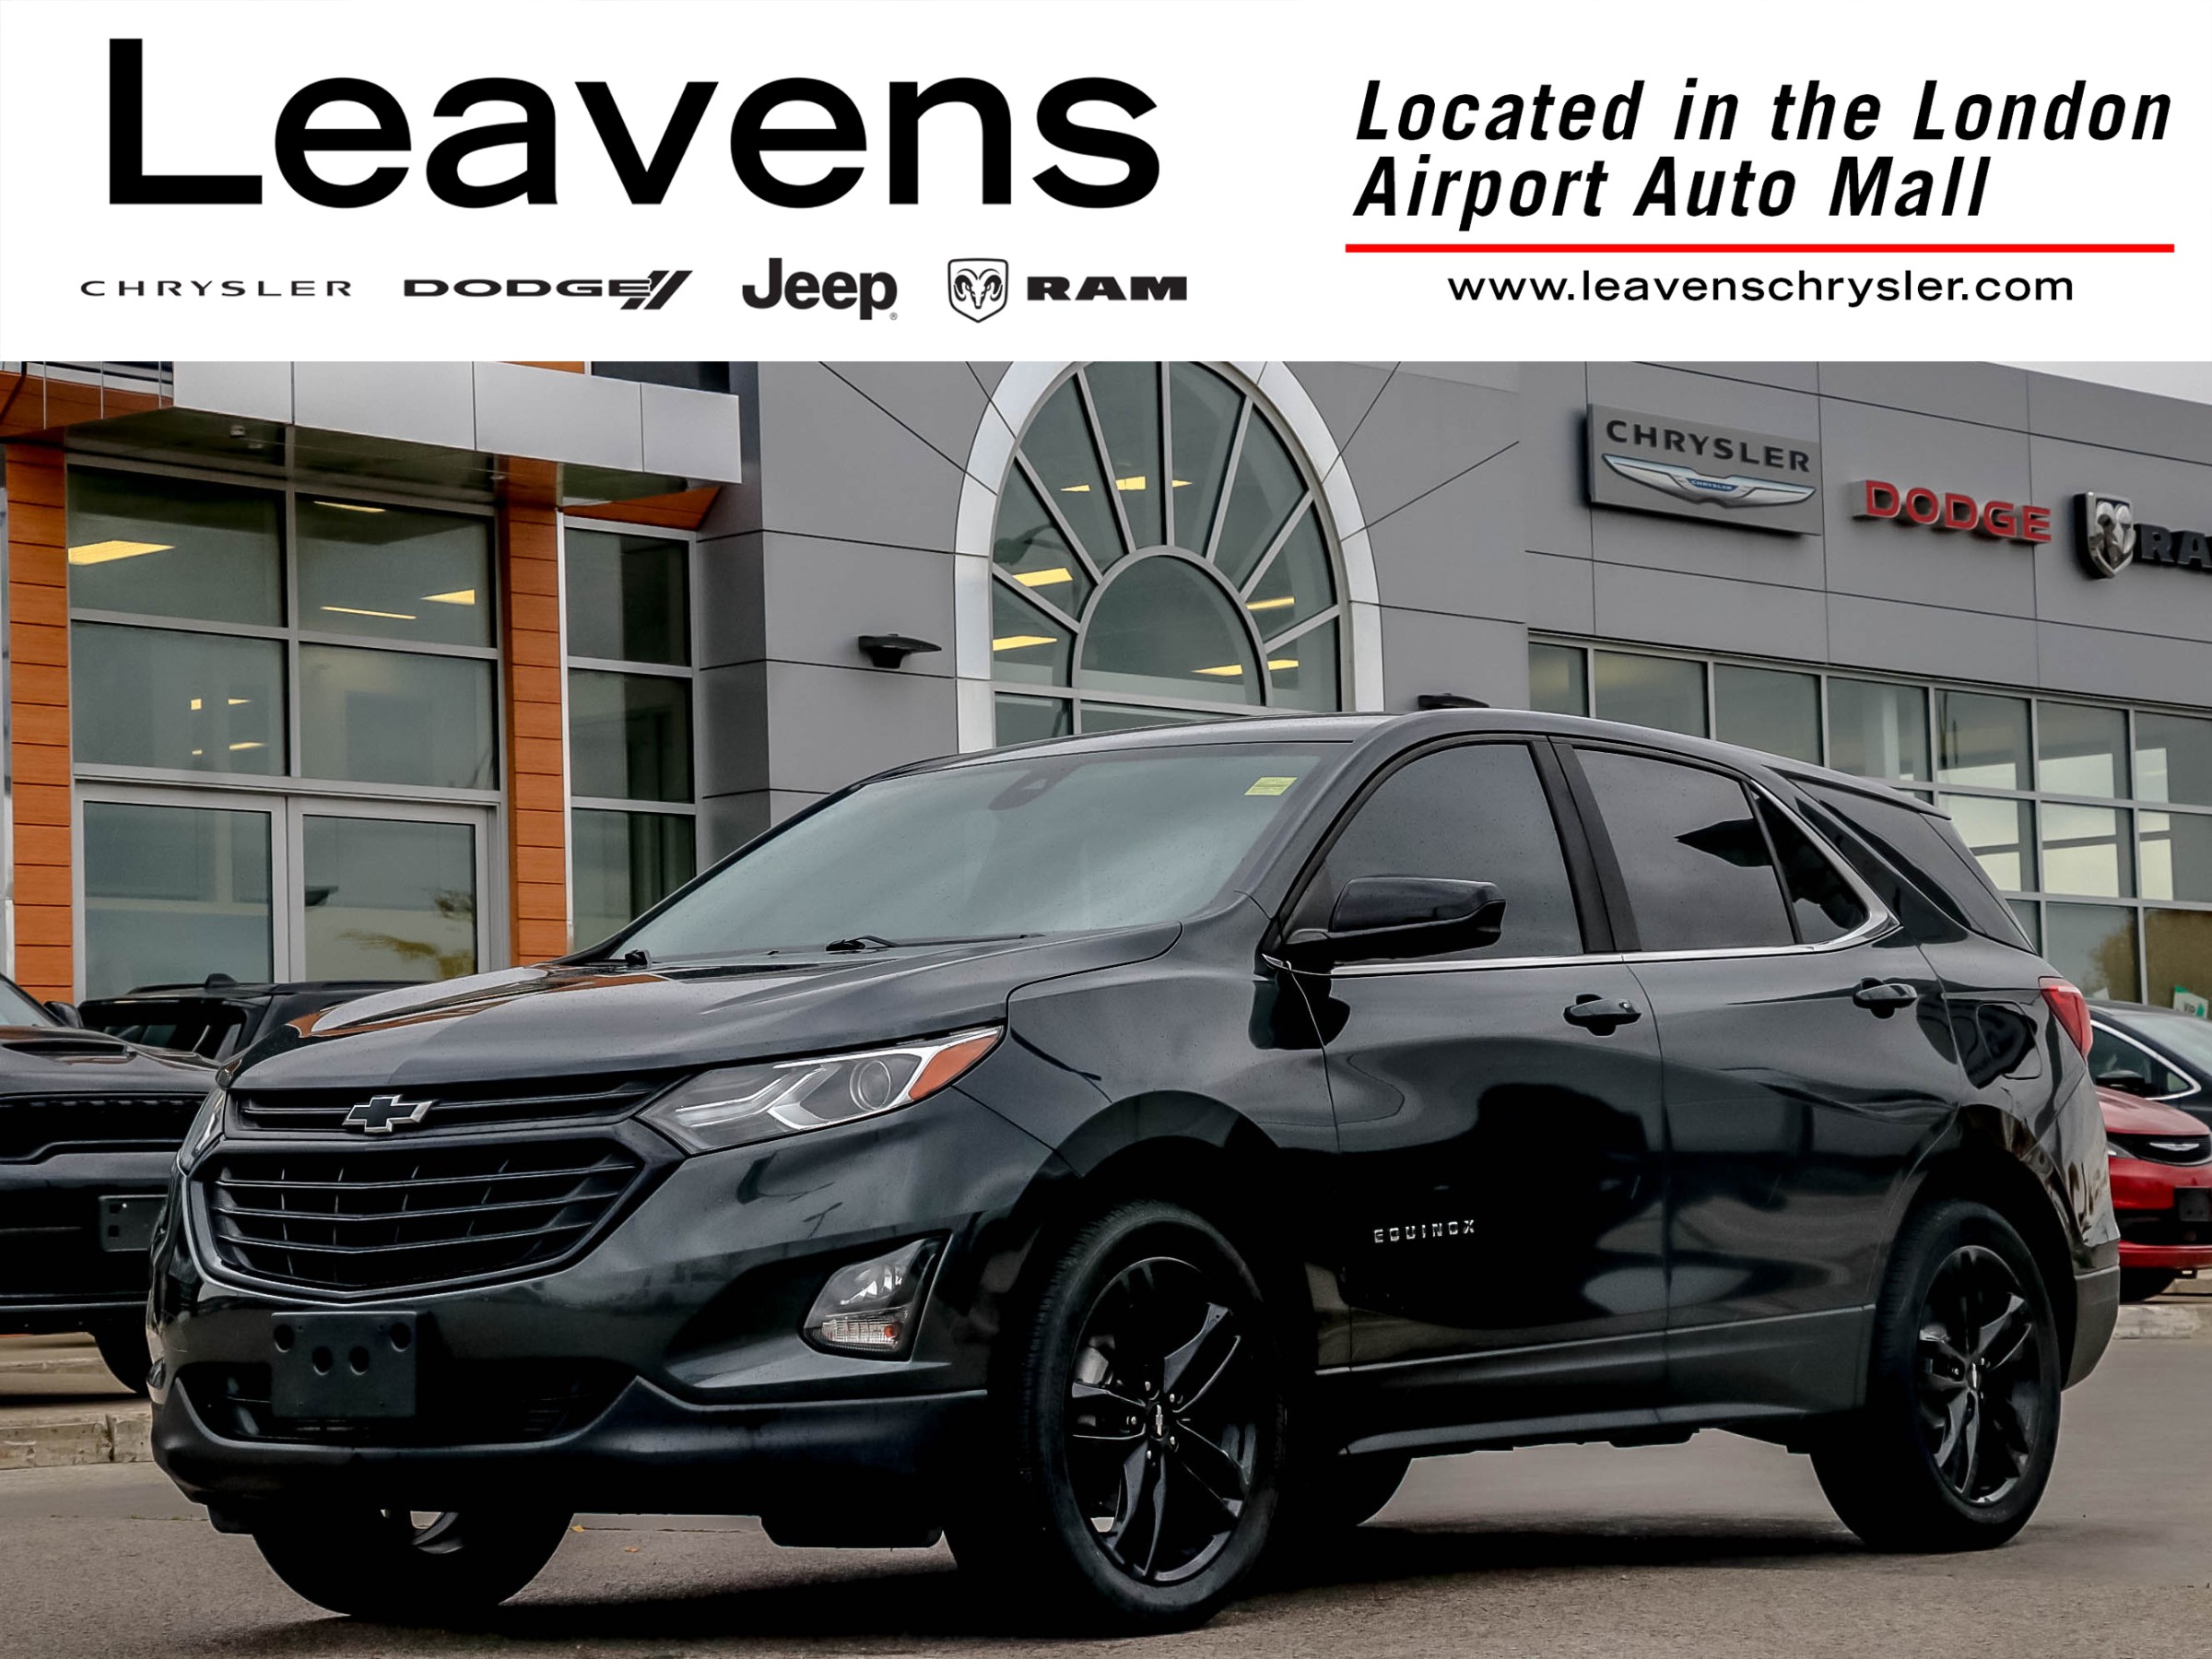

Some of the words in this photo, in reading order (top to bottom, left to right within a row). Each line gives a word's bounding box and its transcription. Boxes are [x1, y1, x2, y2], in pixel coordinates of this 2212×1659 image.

[1606, 418, 1811, 473] CHRYSLER
[1865, 478, 2052, 543] DODGE
[2136, 523, 2212, 569] RA
[1373, 1219, 1475, 1243] EQUINOX
